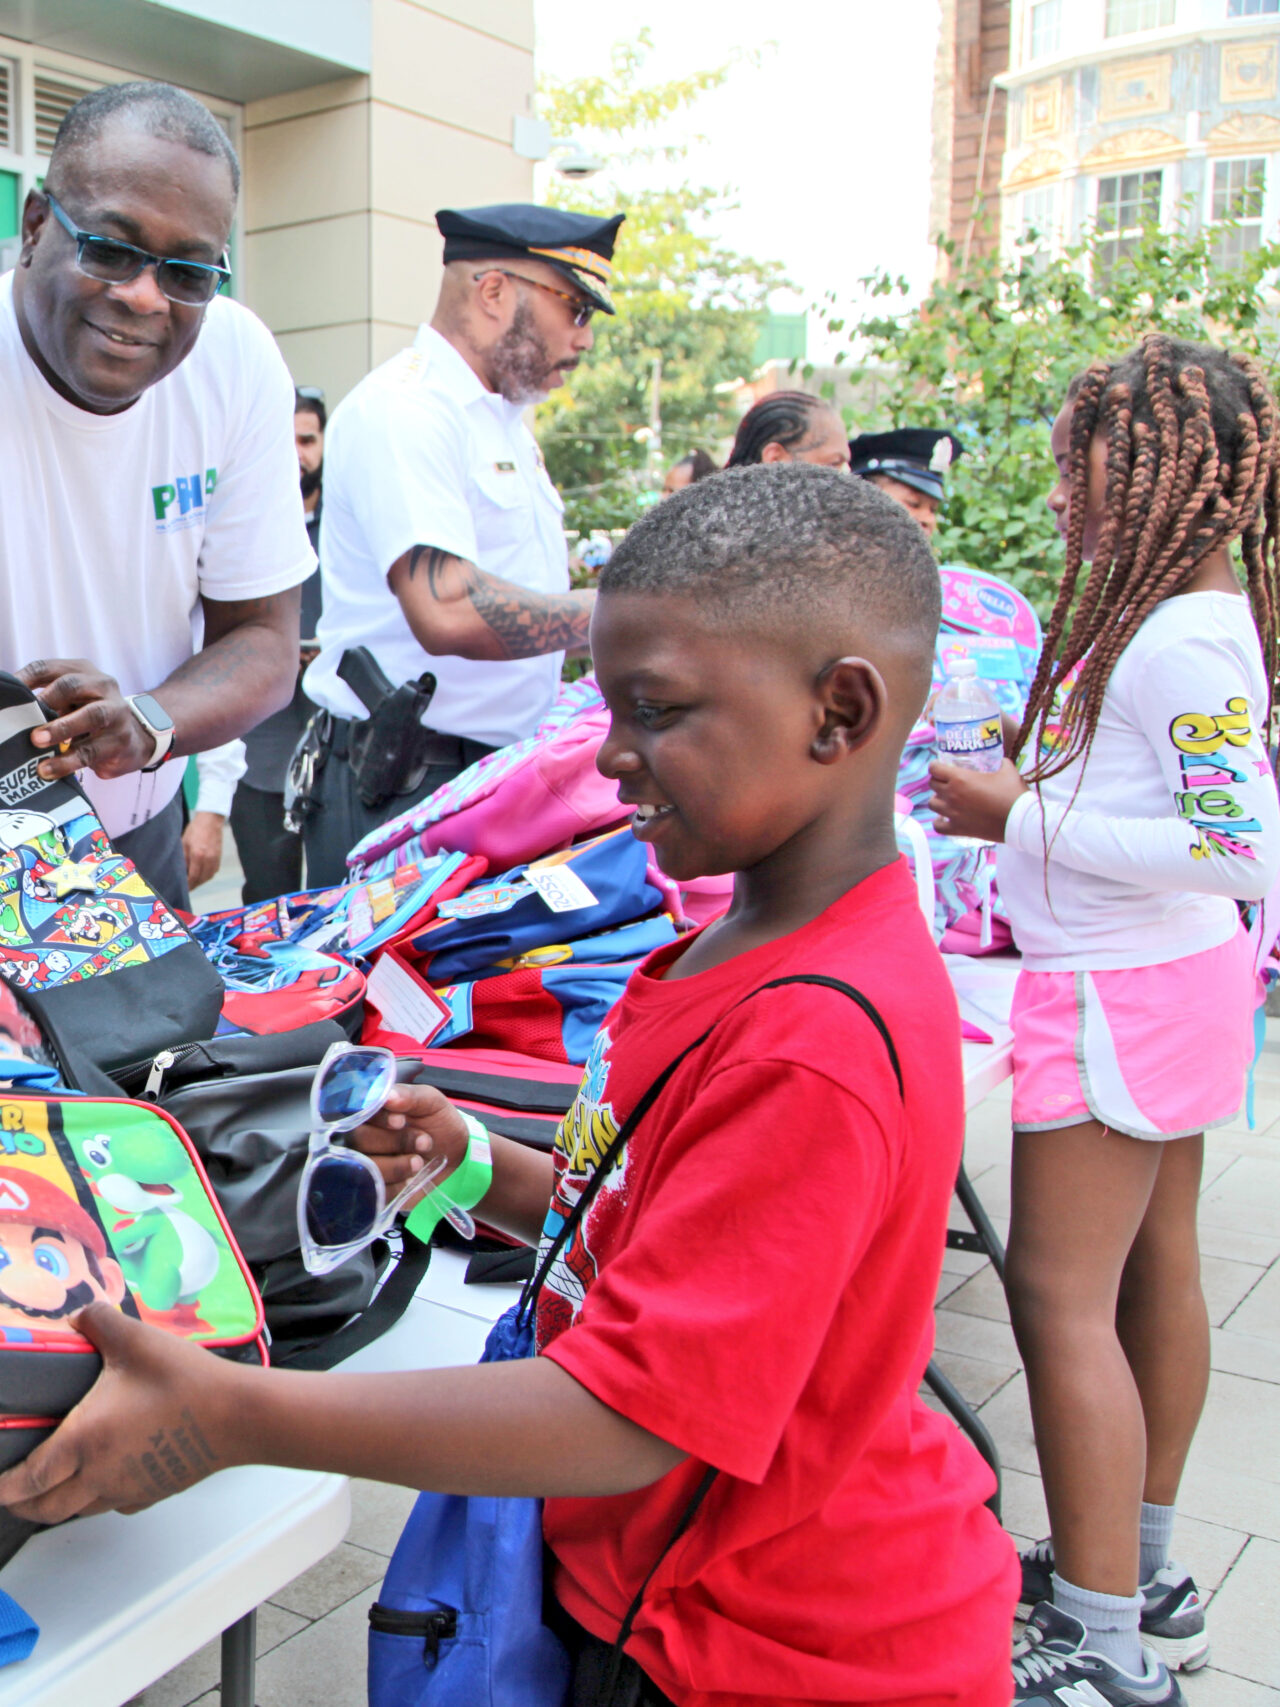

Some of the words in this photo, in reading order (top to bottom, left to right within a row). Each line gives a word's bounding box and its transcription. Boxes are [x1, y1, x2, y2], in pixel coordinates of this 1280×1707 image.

[152, 467, 217, 521] PHA
[945, 729, 981, 741] DEER
[946, 738, 984, 751] PARK
[6, 775, 53, 803] MARI
[92, 935, 135, 969] MARIO
